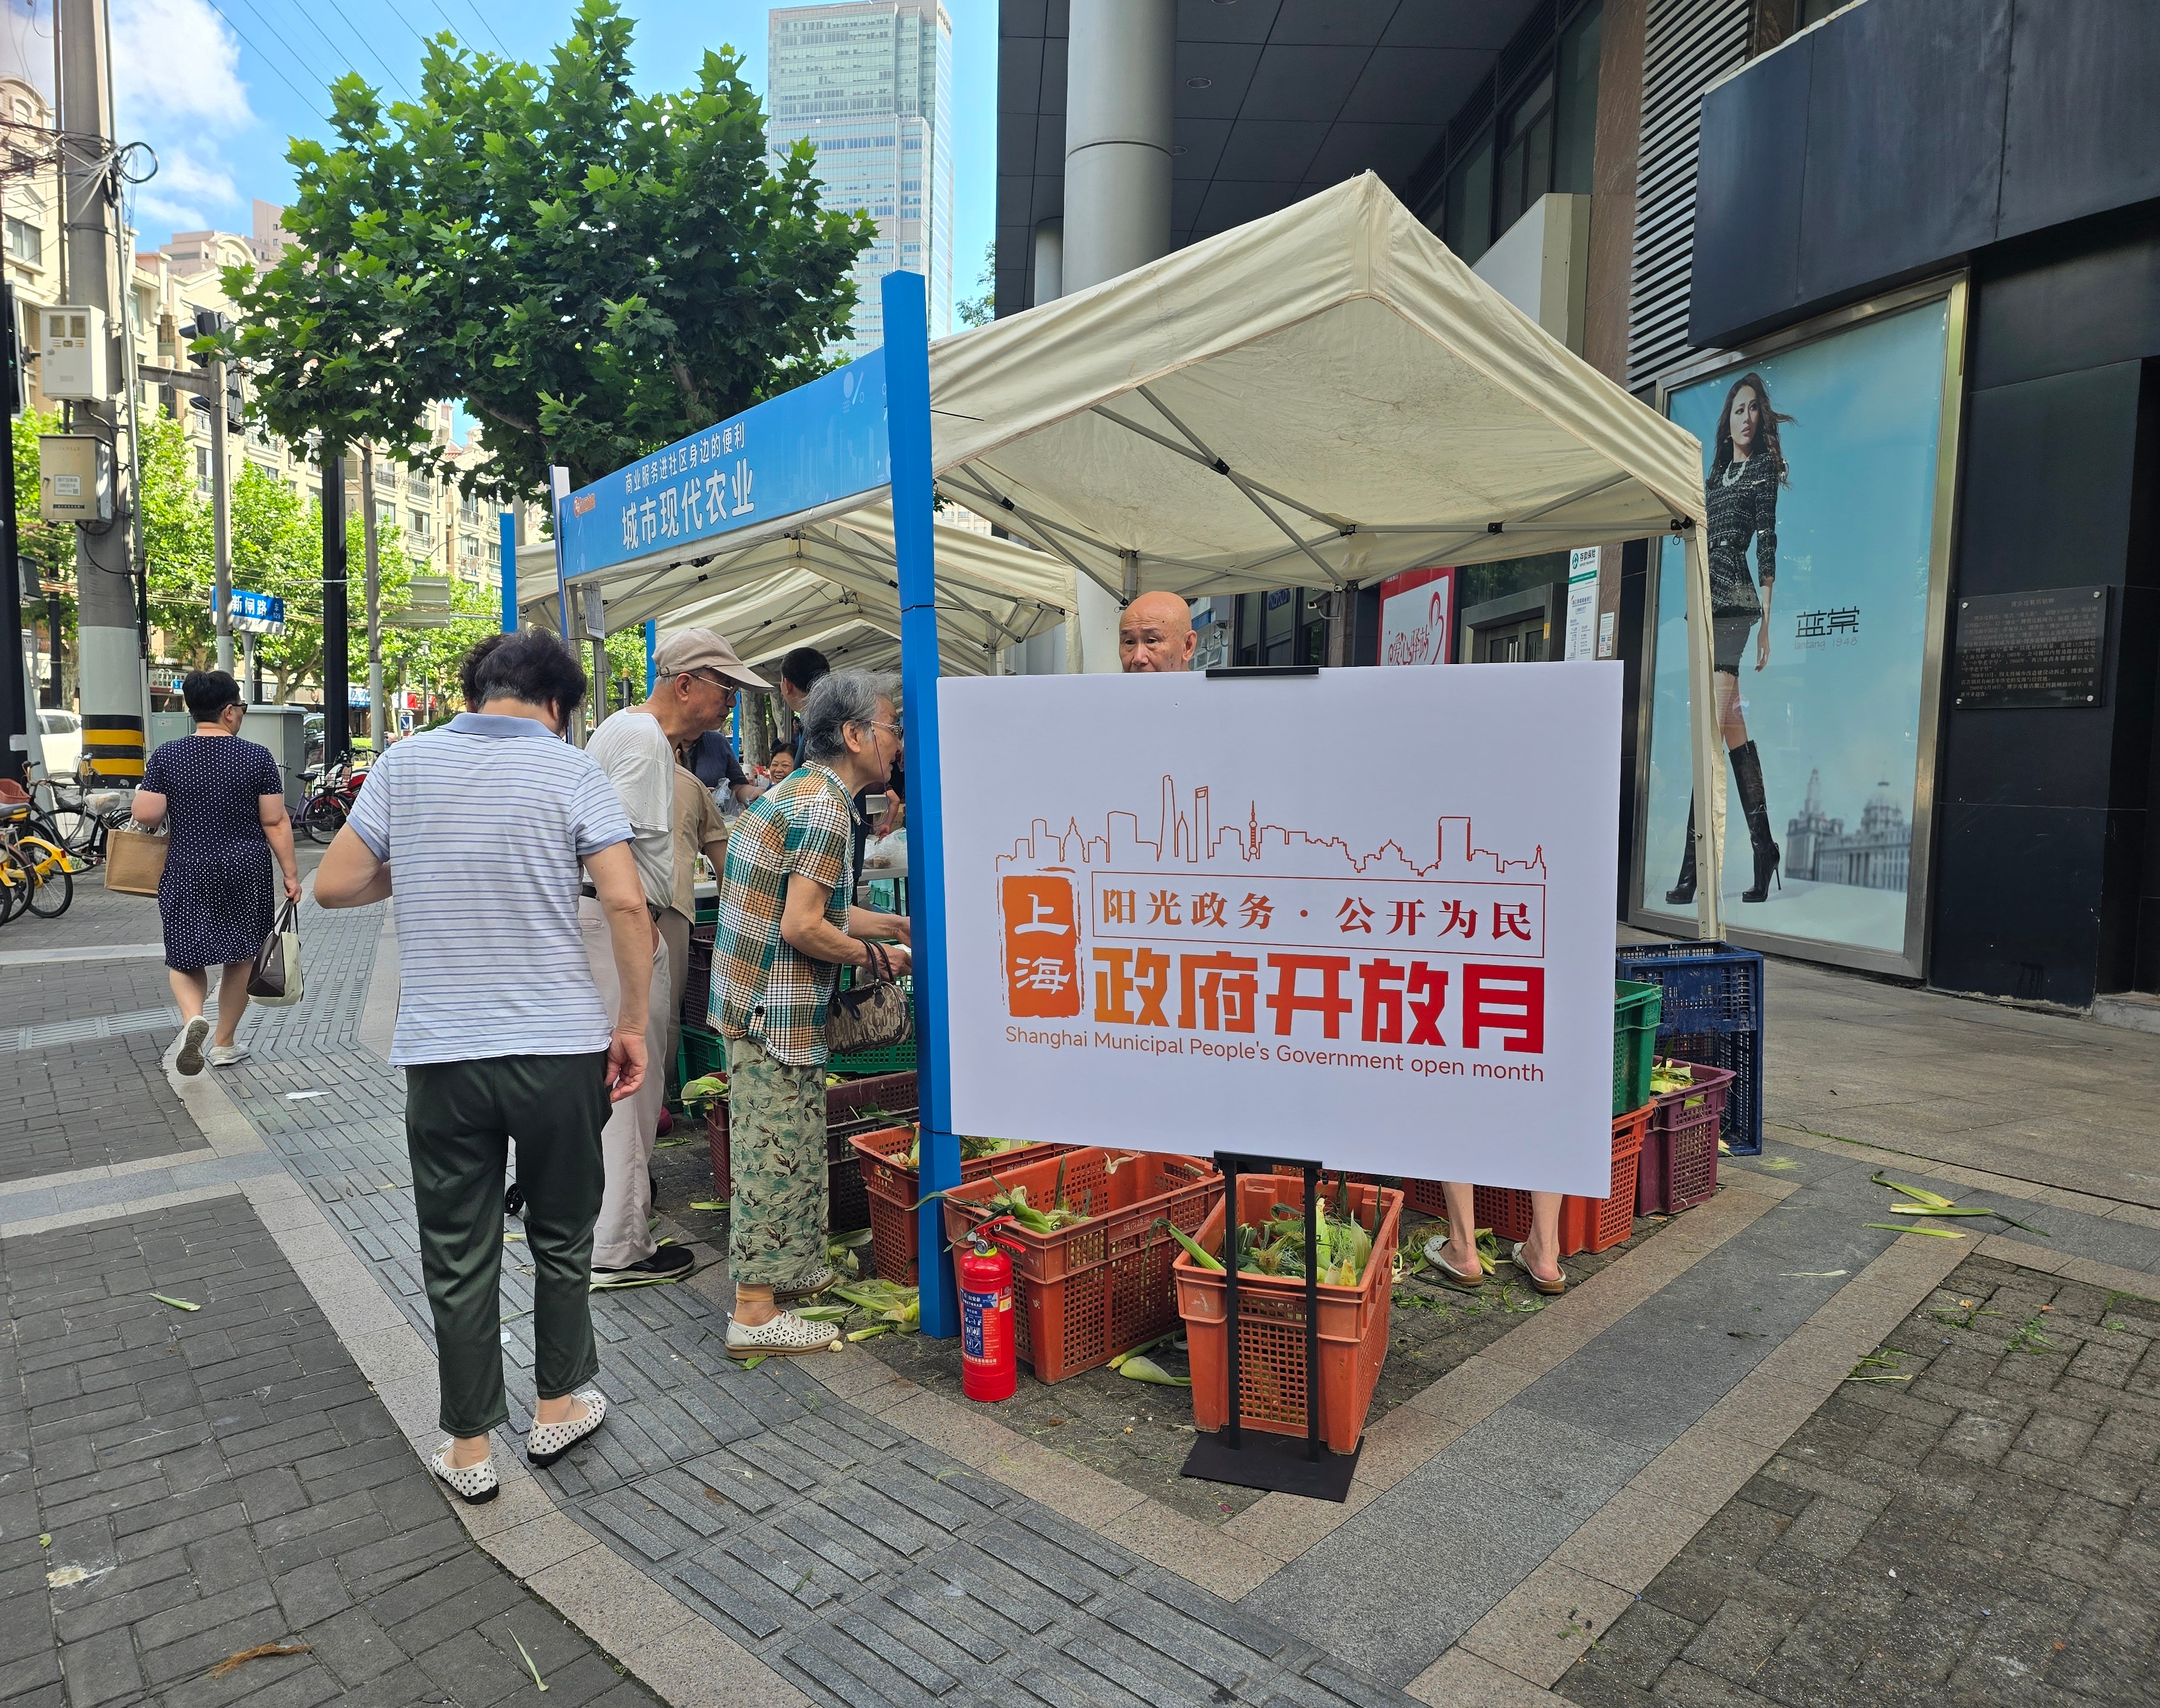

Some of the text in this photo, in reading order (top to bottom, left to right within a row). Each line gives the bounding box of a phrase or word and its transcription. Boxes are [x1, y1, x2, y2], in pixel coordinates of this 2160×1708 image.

[625, 420, 744, 495] 商业服务进社区身边的便利
[622, 458, 755, 551] 城市现代农业
[232, 594, 267, 616] 新闸路
[1796, 606, 1860, 638] 蓝棠
[1388, 624, 1430, 666] 爱心驿站
[1794, 636, 1858, 651] lantang 1948
[1014, 893, 1071, 994] 上海
[1092, 947, 1545, 1054] 政府开放月
[1005, 1026, 1544, 1082] Shanghai Municipal People's Government open month
[1123, 1215, 1151, 1232] 城市蔬菜
